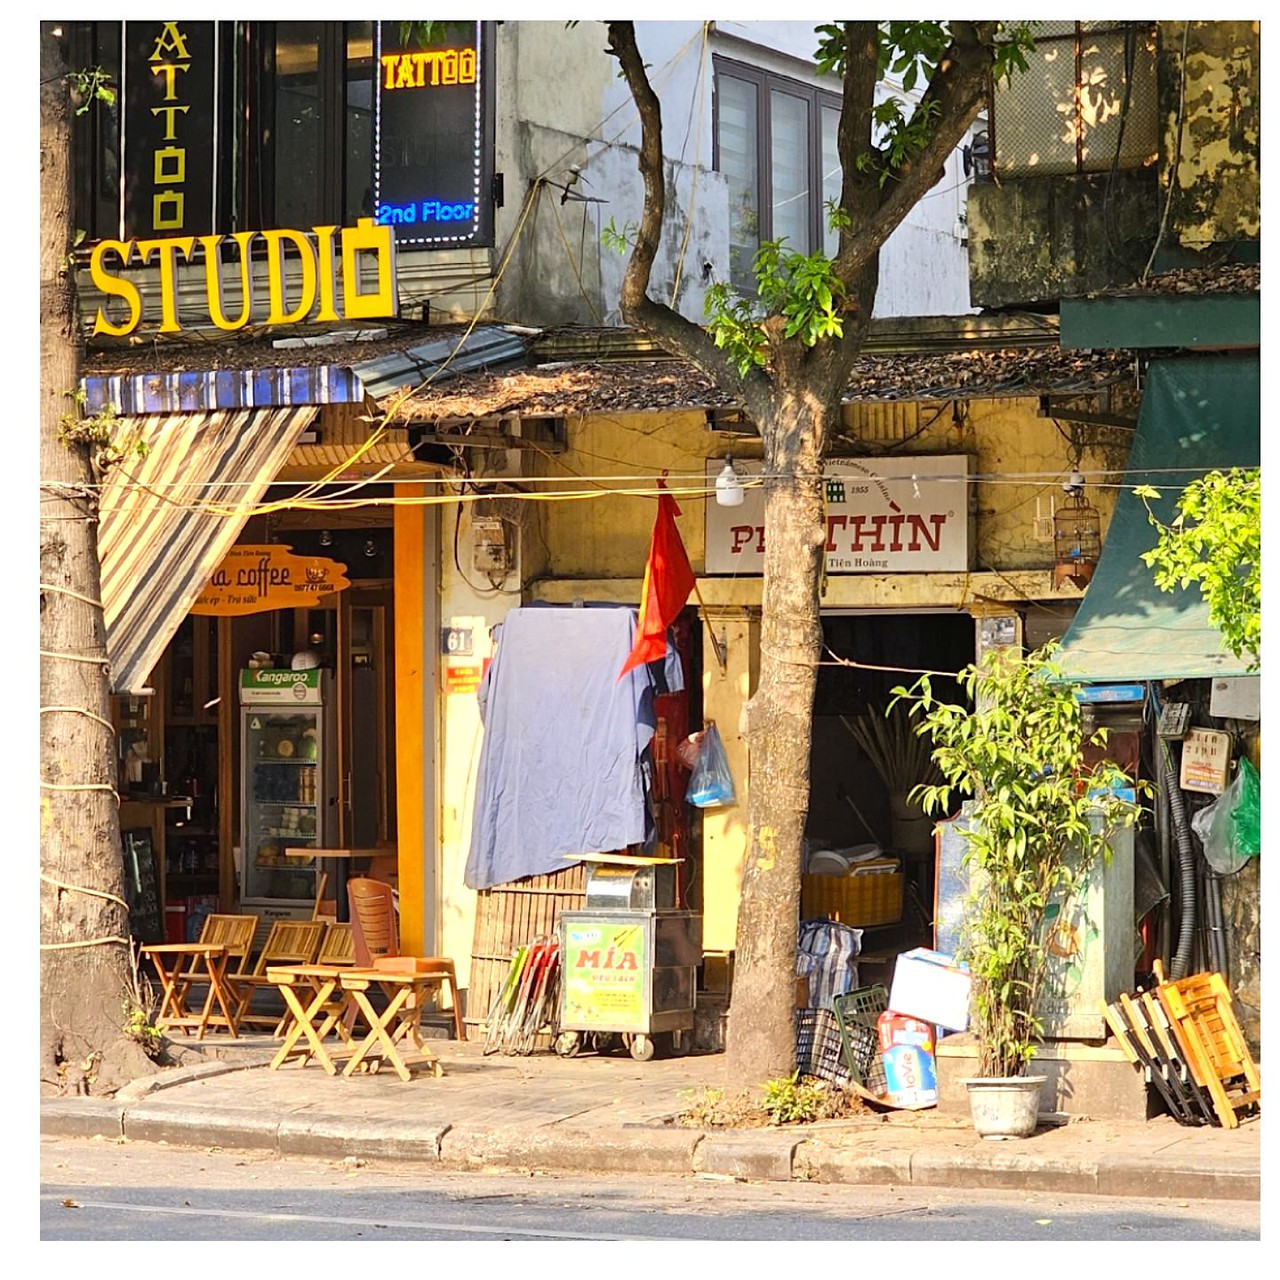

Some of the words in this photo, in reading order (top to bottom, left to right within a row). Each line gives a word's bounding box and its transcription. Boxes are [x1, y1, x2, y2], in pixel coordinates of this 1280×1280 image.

[381, 48, 476, 89] TATTOO
[379, 202, 416, 224] 2nd
[422, 200, 475, 222] Floor
[90, 218, 396, 337] STUDIO
[870, 472, 892, 502] Cisine
[822, 501, 947, 553] THÌN
[236, 557, 292, 597] coffee
[855, 557, 888, 569] Hoàng
[253, 670, 308, 685] Kangaroo
[575, 946, 638, 970] MÍA
